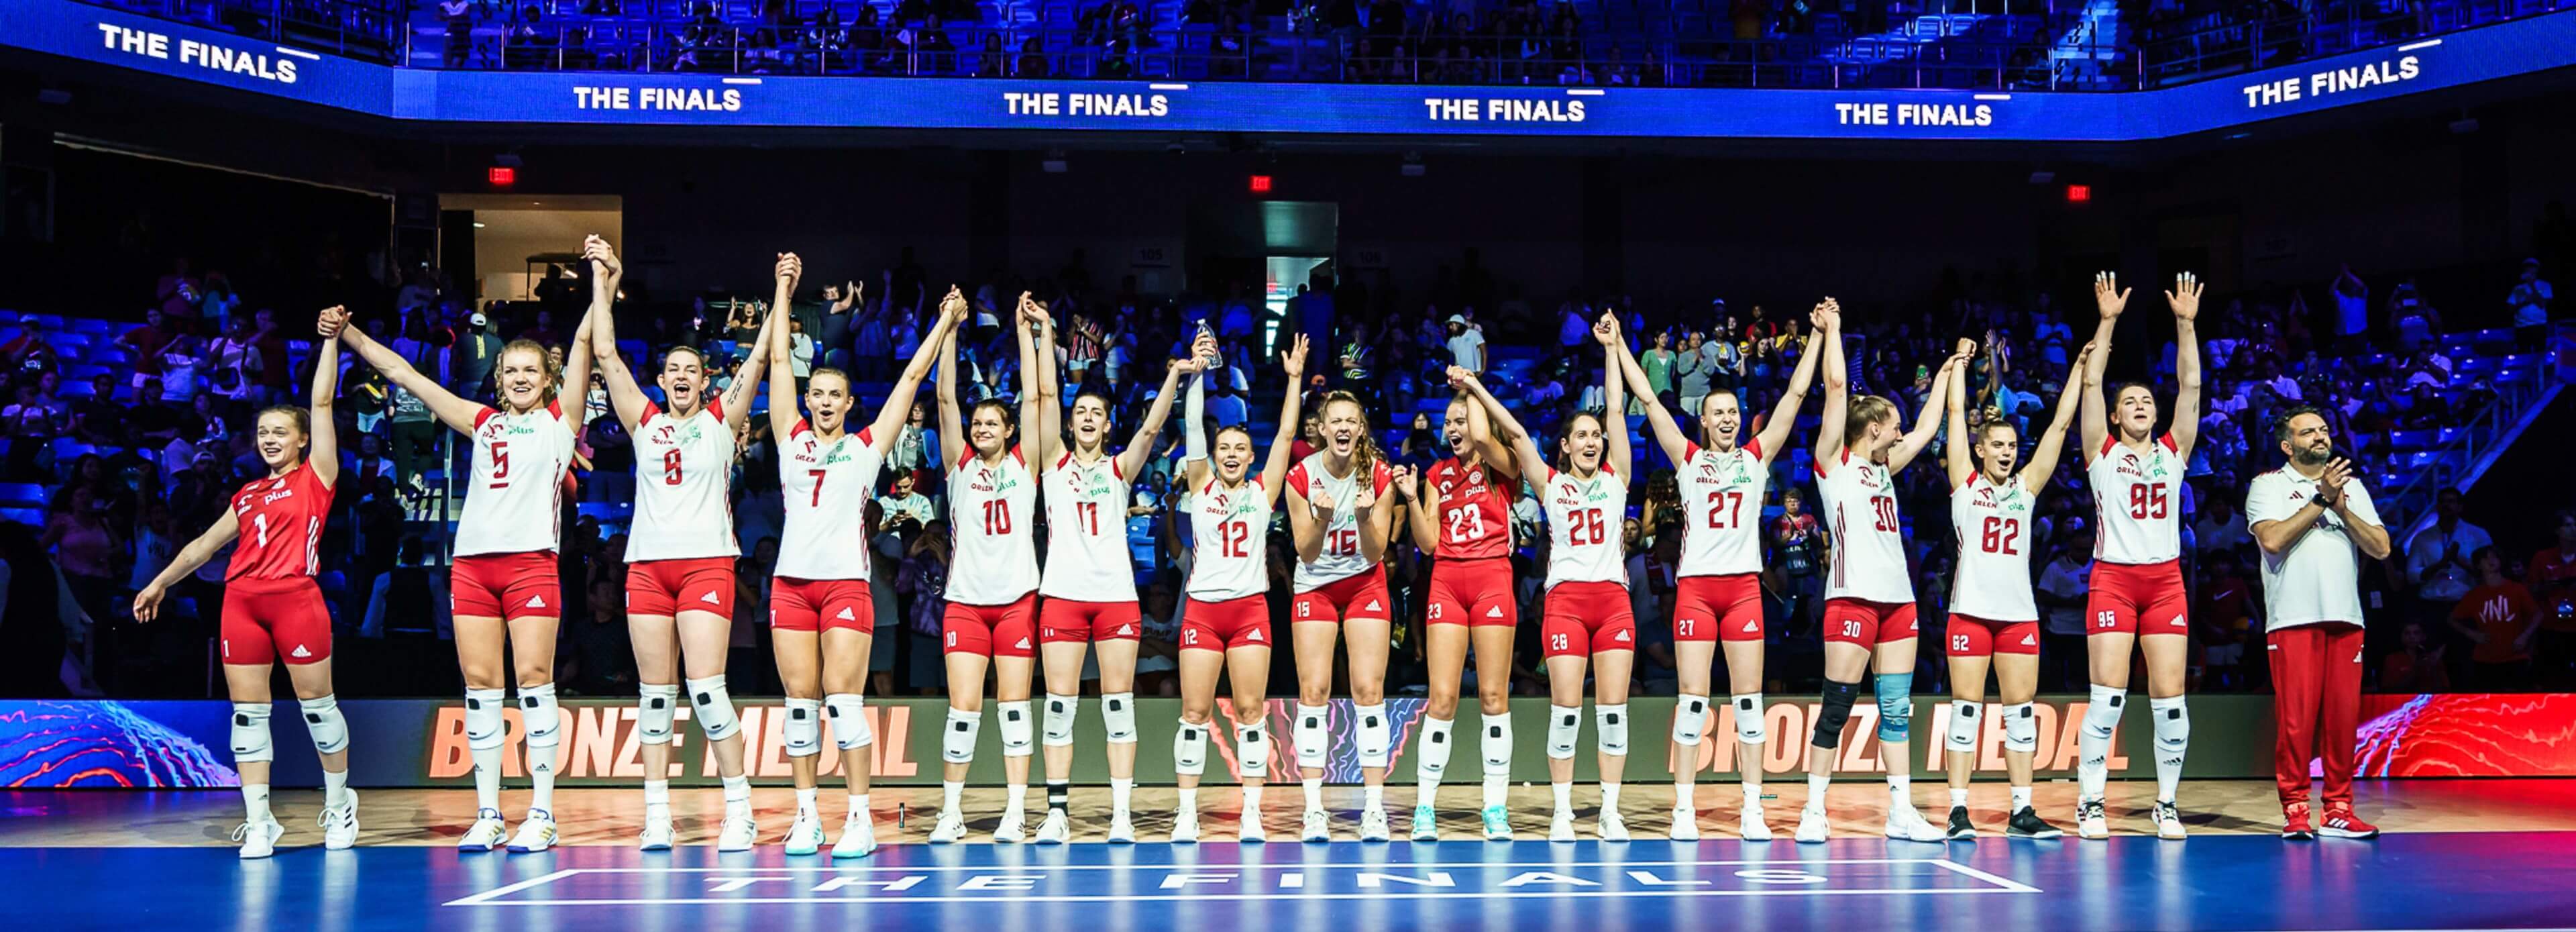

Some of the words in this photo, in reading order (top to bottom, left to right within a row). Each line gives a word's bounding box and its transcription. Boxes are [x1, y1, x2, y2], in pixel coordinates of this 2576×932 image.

[99, 23, 168, 59] THE
[180, 40, 297, 83] FINALS
[2244, 77, 2301, 108] THE
[2311, 56, 2419, 97] FINALS
[574, 87, 630, 109] THE
[639, 88, 741, 111] FINALS
[1004, 93, 1059, 115] THE
[1069, 93, 1168, 117] FINALS
[1425, 99, 1479, 121] THE
[1489, 99, 1585, 122] FINALS
[1835, 103, 1888, 125] THE
[1897, 104, 1992, 126] FINALS
[508, 423, 535, 435] plus
[491, 442, 509, 479] 5
[664, 448, 683, 485] 9
[826, 453, 851, 465] plus
[1696, 476, 1719, 485] ORLEN
[2116, 467, 2143, 478] ORLEN
[264, 488, 293, 505] plus
[809, 469, 826, 507] 7
[971, 482, 994, 493] ORLEN
[1464, 485, 1487, 498] plus
[1707, 492, 1743, 529] 27
[1972, 499, 1998, 509] ORLEN
[2130, 482, 2167, 520] 95
[983, 499, 1012, 536] 10
[1077, 501, 1098, 537] 11
[1448, 503, 1485, 543] 23
[1870, 497, 1898, 533] 30
[254, 513, 269, 549] 1
[1568, 507, 1605, 547] 26
[1981, 516, 2019, 556] 62
[1218, 521, 1248, 558] 12
[1328, 530, 1356, 556] 15
[1297, 601, 1310, 618] 15
[1428, 603, 1442, 619] 23
[2098, 611, 2115, 628] 95
[2479, 594, 2516, 624] VNL
[1184, 628, 1198, 645] 12
[1679, 619, 1695, 636] 27
[1843, 620, 1861, 638] 30
[223, 639, 229, 657] 1
[946, 631, 957, 648] 10
[1552, 633, 1568, 650] 26
[1953, 635, 1969, 652] 62
[702, 876, 1048, 892] THE
[1160, 870, 1828, 889] FINALS
